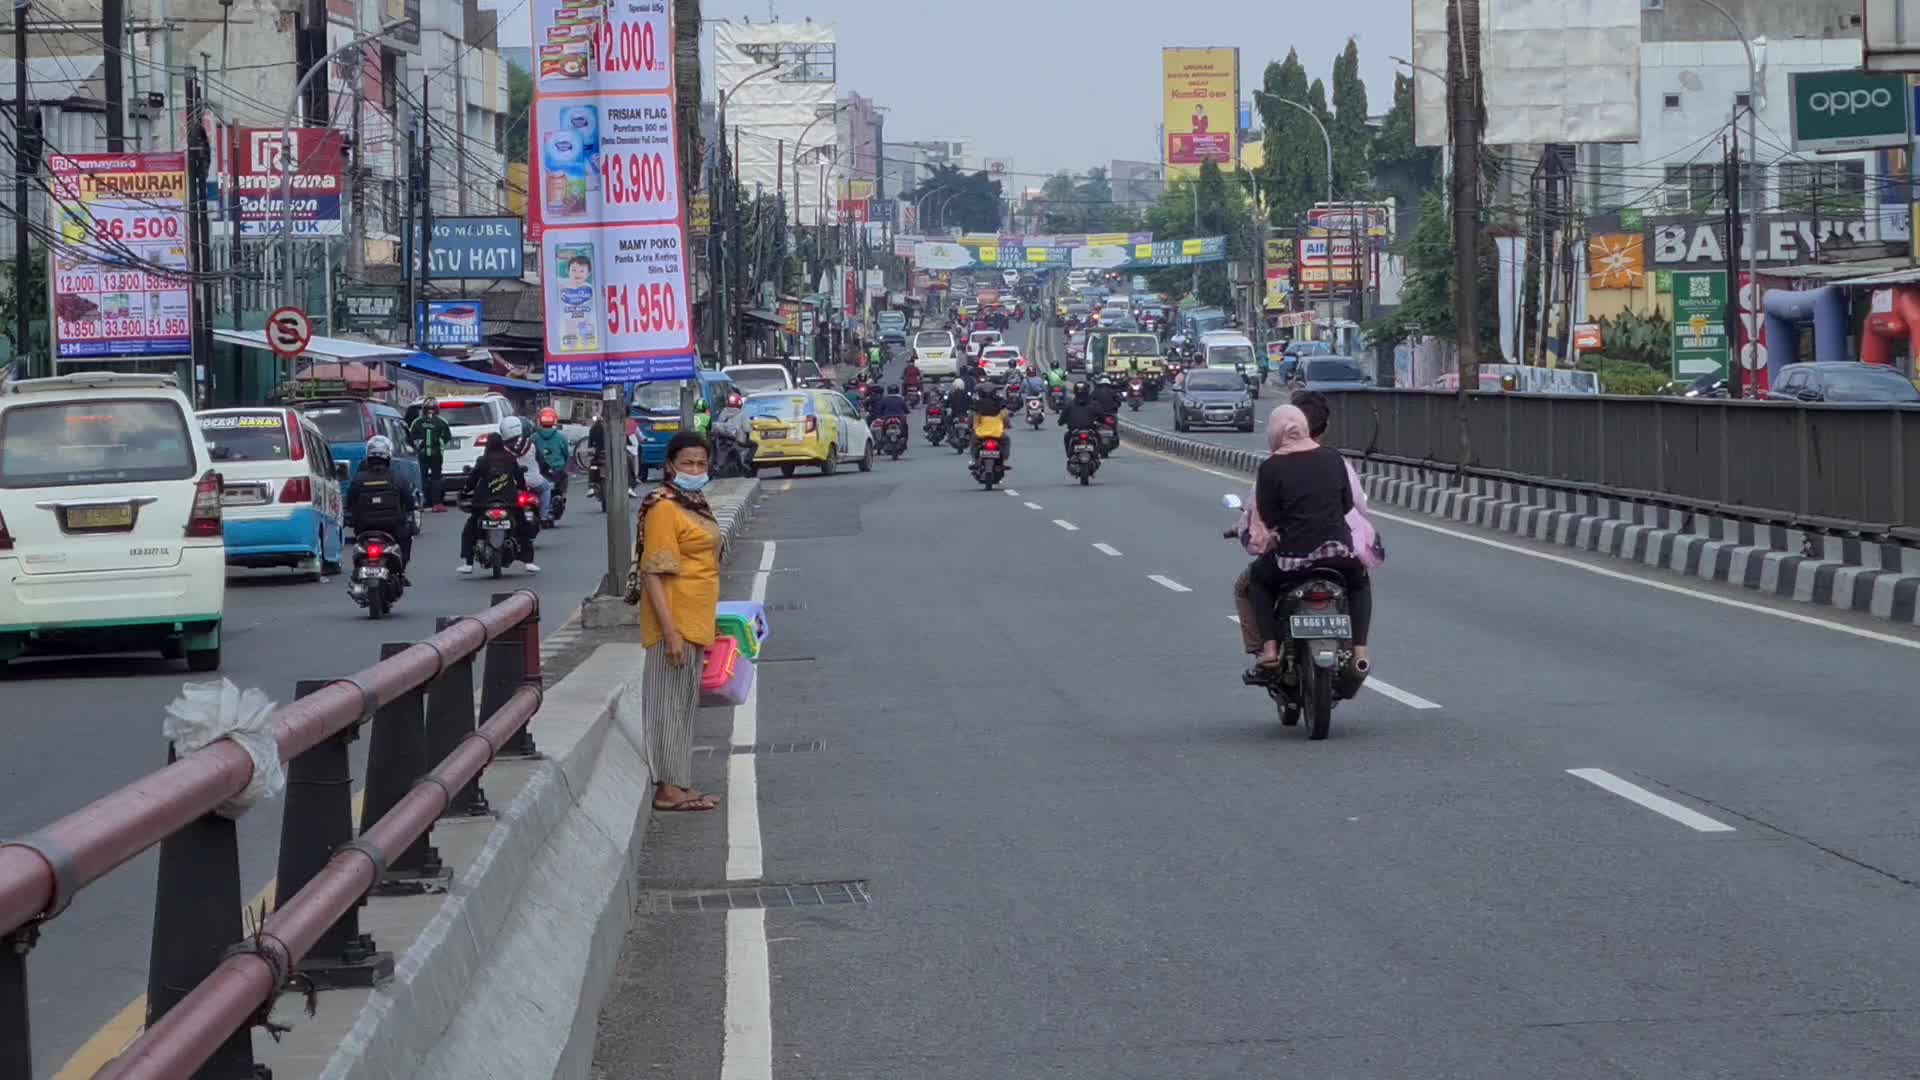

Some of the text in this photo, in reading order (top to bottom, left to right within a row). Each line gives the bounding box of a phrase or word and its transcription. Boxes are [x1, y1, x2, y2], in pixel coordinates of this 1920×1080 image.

[593, 21, 654, 71] 12.000
[1810, 88, 1891, 116] oppo
[608, 107, 668, 120] FRISIAN FLAG
[83, 175, 183, 192] TERMURAH
[601, 153, 665, 204] 13.900
[96, 217, 178, 239] 26.500
[455, 224, 512, 236] MEUBEL
[619, 237, 677, 251] MAMY POKO
[469, 247, 516, 271] HATI
[61, 276, 94, 292] 12.000
[104, 274, 140, 289] 13.900
[607, 283, 675, 335] 51.950
[105, 320, 142, 336] 33.900
[148, 319, 186, 334] 51.950
[547, 364, 571, 382] 5M
